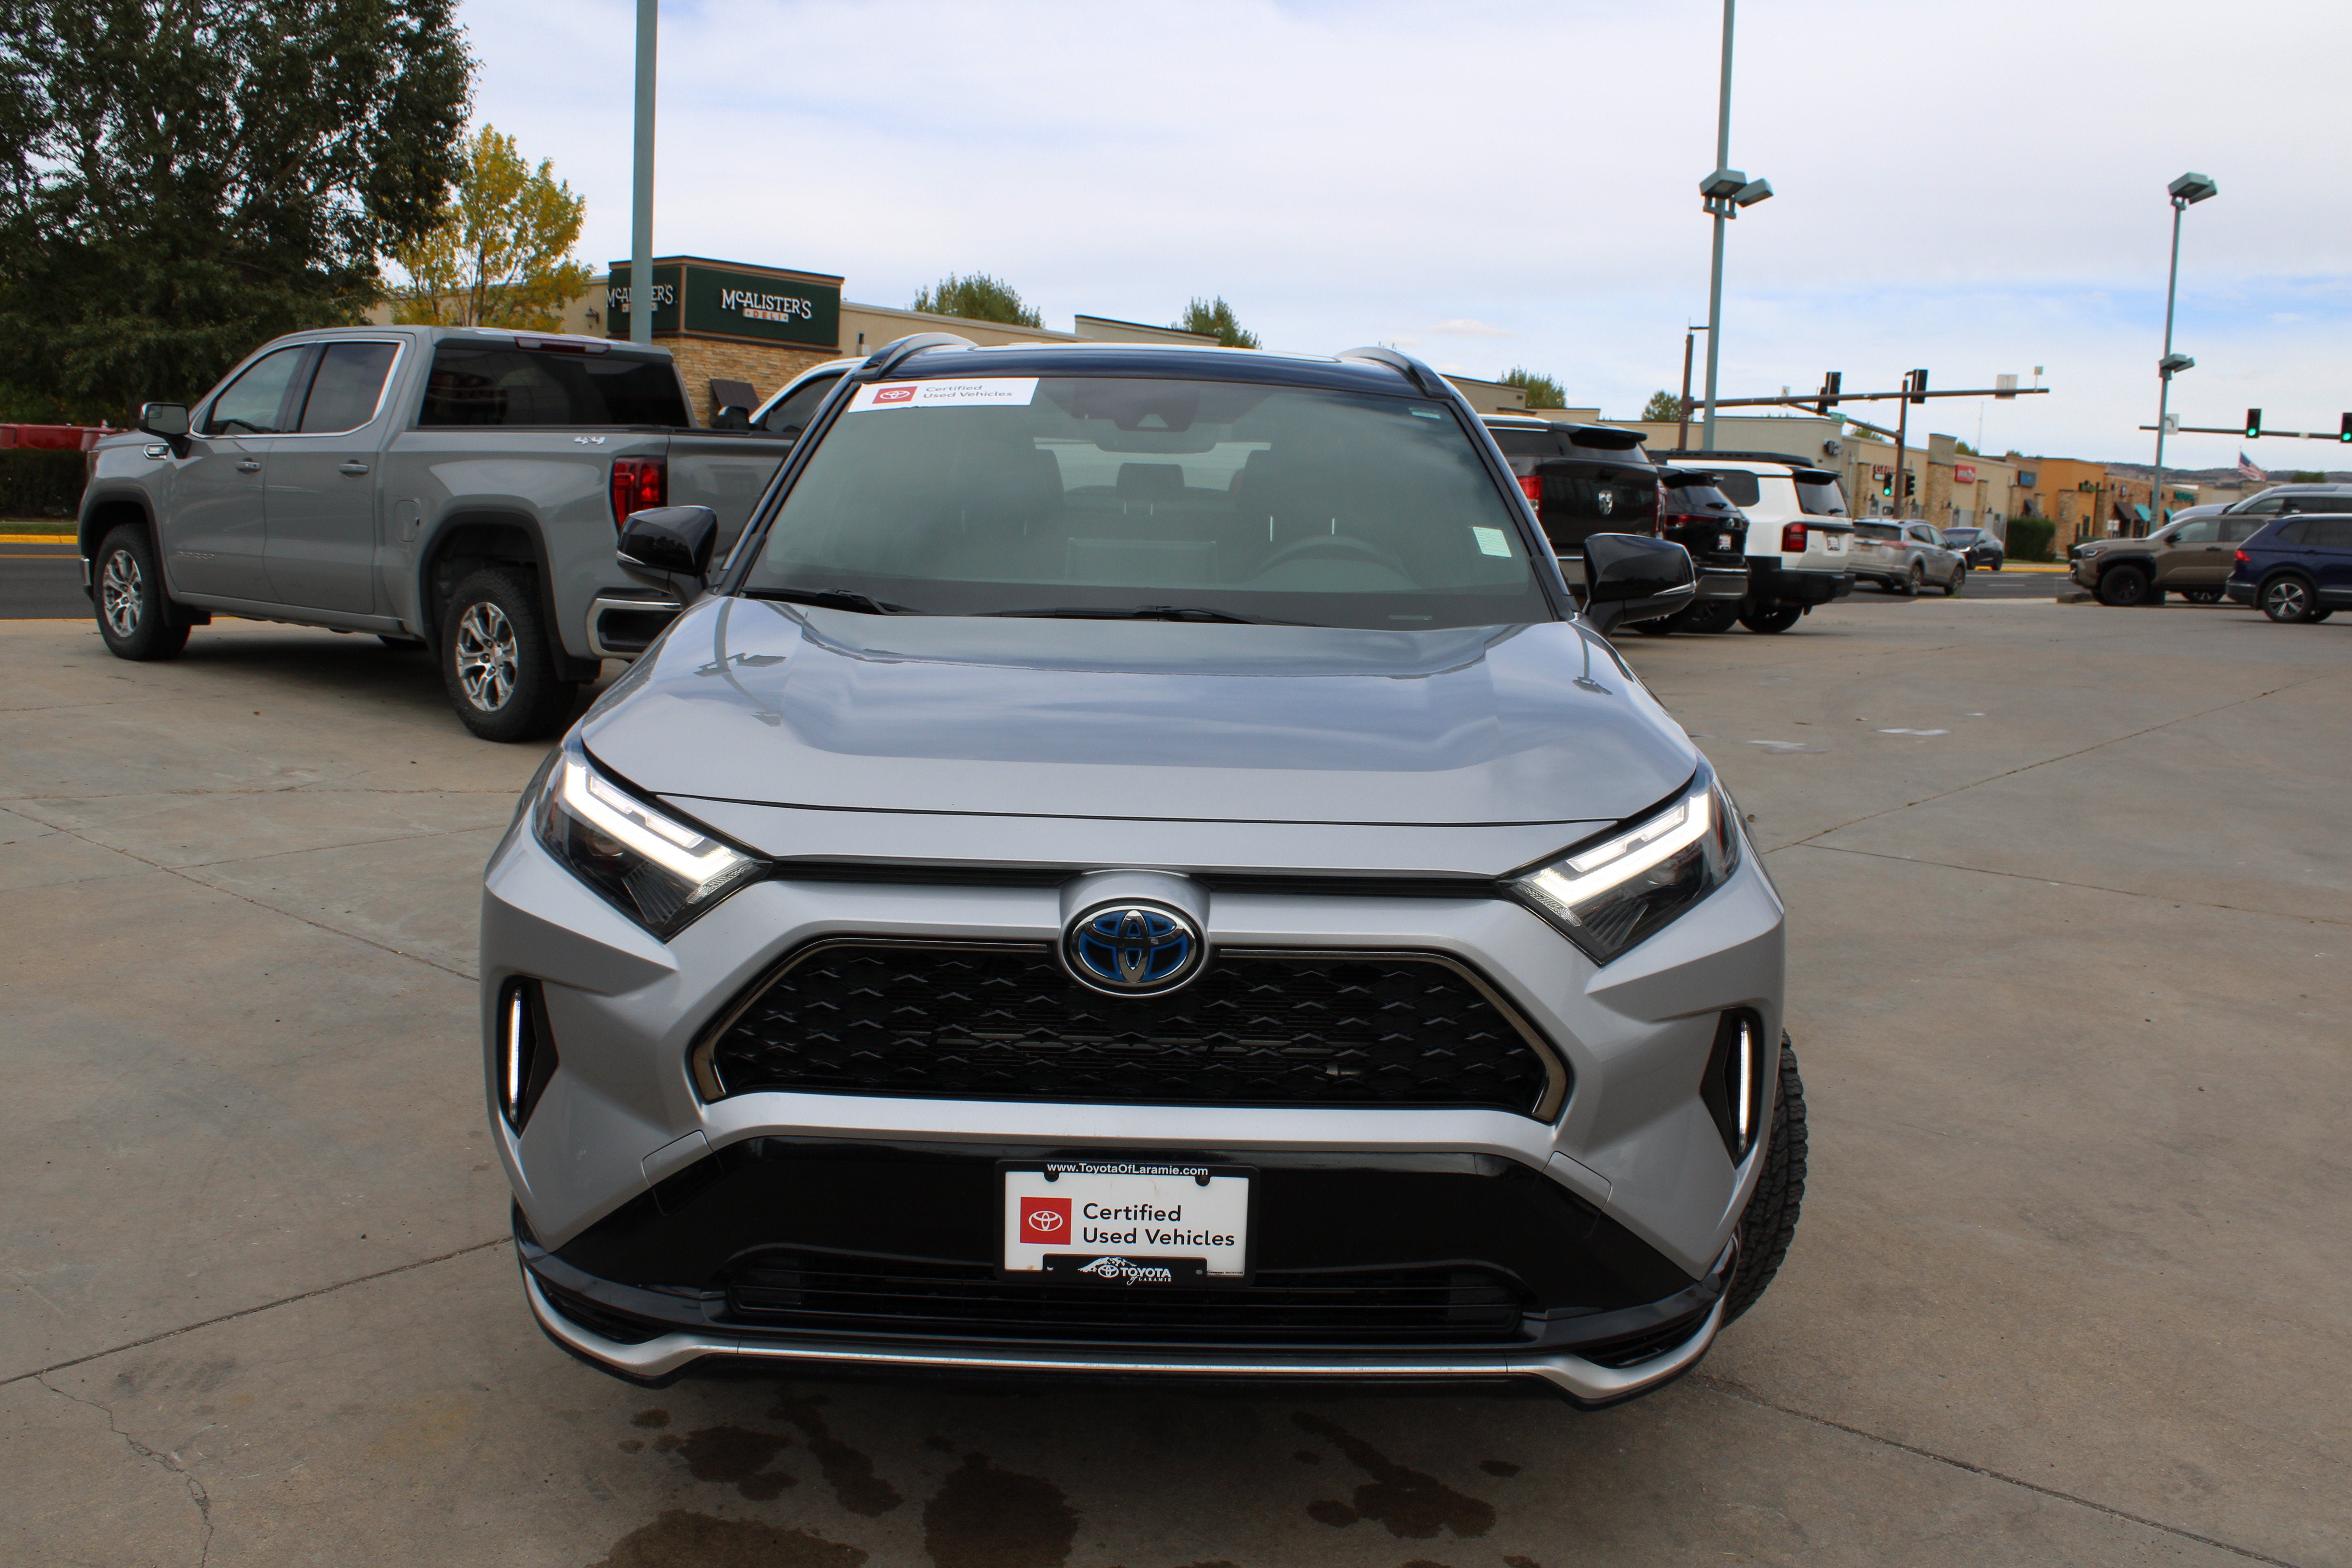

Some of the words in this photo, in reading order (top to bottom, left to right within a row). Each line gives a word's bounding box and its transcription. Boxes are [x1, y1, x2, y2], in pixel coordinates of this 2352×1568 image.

[753, 310, 781, 321] DELI
[1047, 1163, 1208, 1176] www.ToyotaOfLaramie.com
[1083, 1203, 1181, 1222] Certified
[1083, 1227, 1137, 1244] Used
[1145, 1228, 1235, 1247] Vehicles
[1120, 1267, 1172, 1278] TOYOTA
[1126, 1275, 1140, 1285] of
